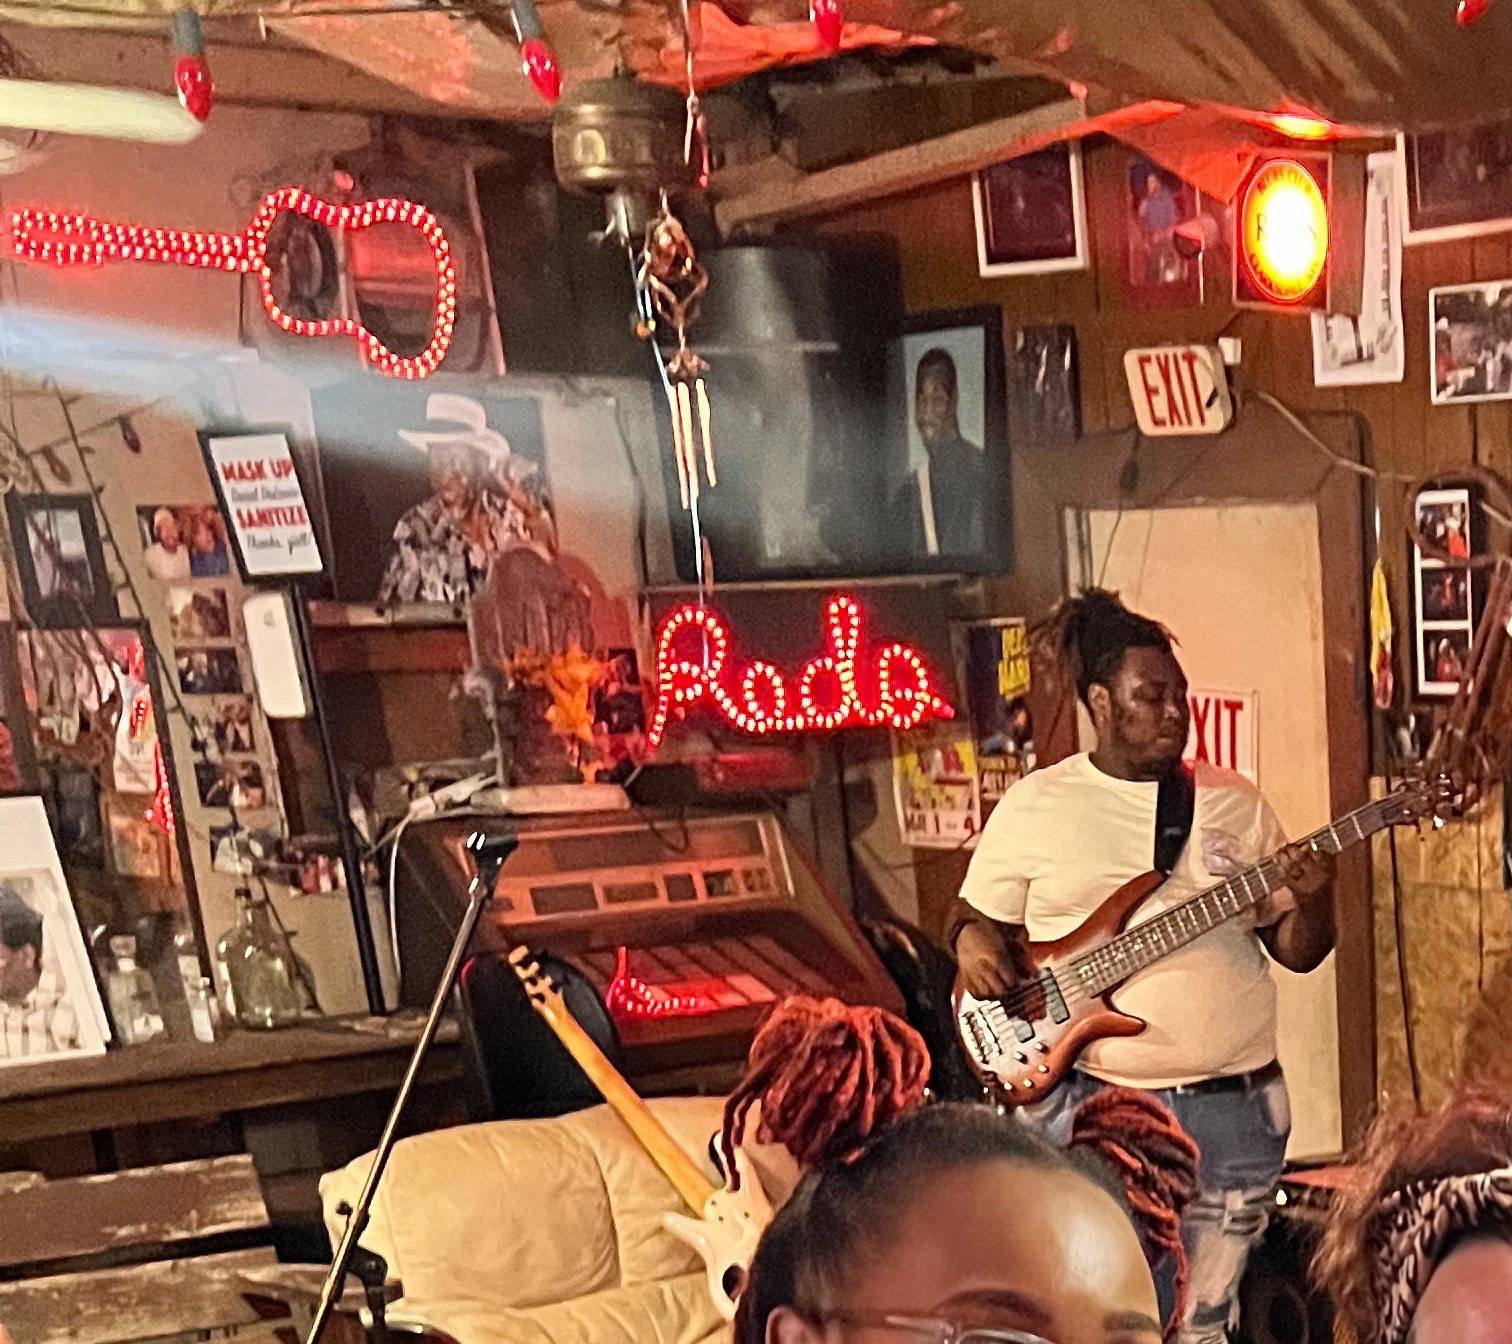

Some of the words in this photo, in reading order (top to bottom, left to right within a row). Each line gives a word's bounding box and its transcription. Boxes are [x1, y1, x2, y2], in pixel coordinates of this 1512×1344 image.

[1138, 351, 1206, 428] EXIT
[221, 458, 267, 483] MASK
[270, 457, 293, 480] UP
[1187, 696, 1244, 771] XIT
